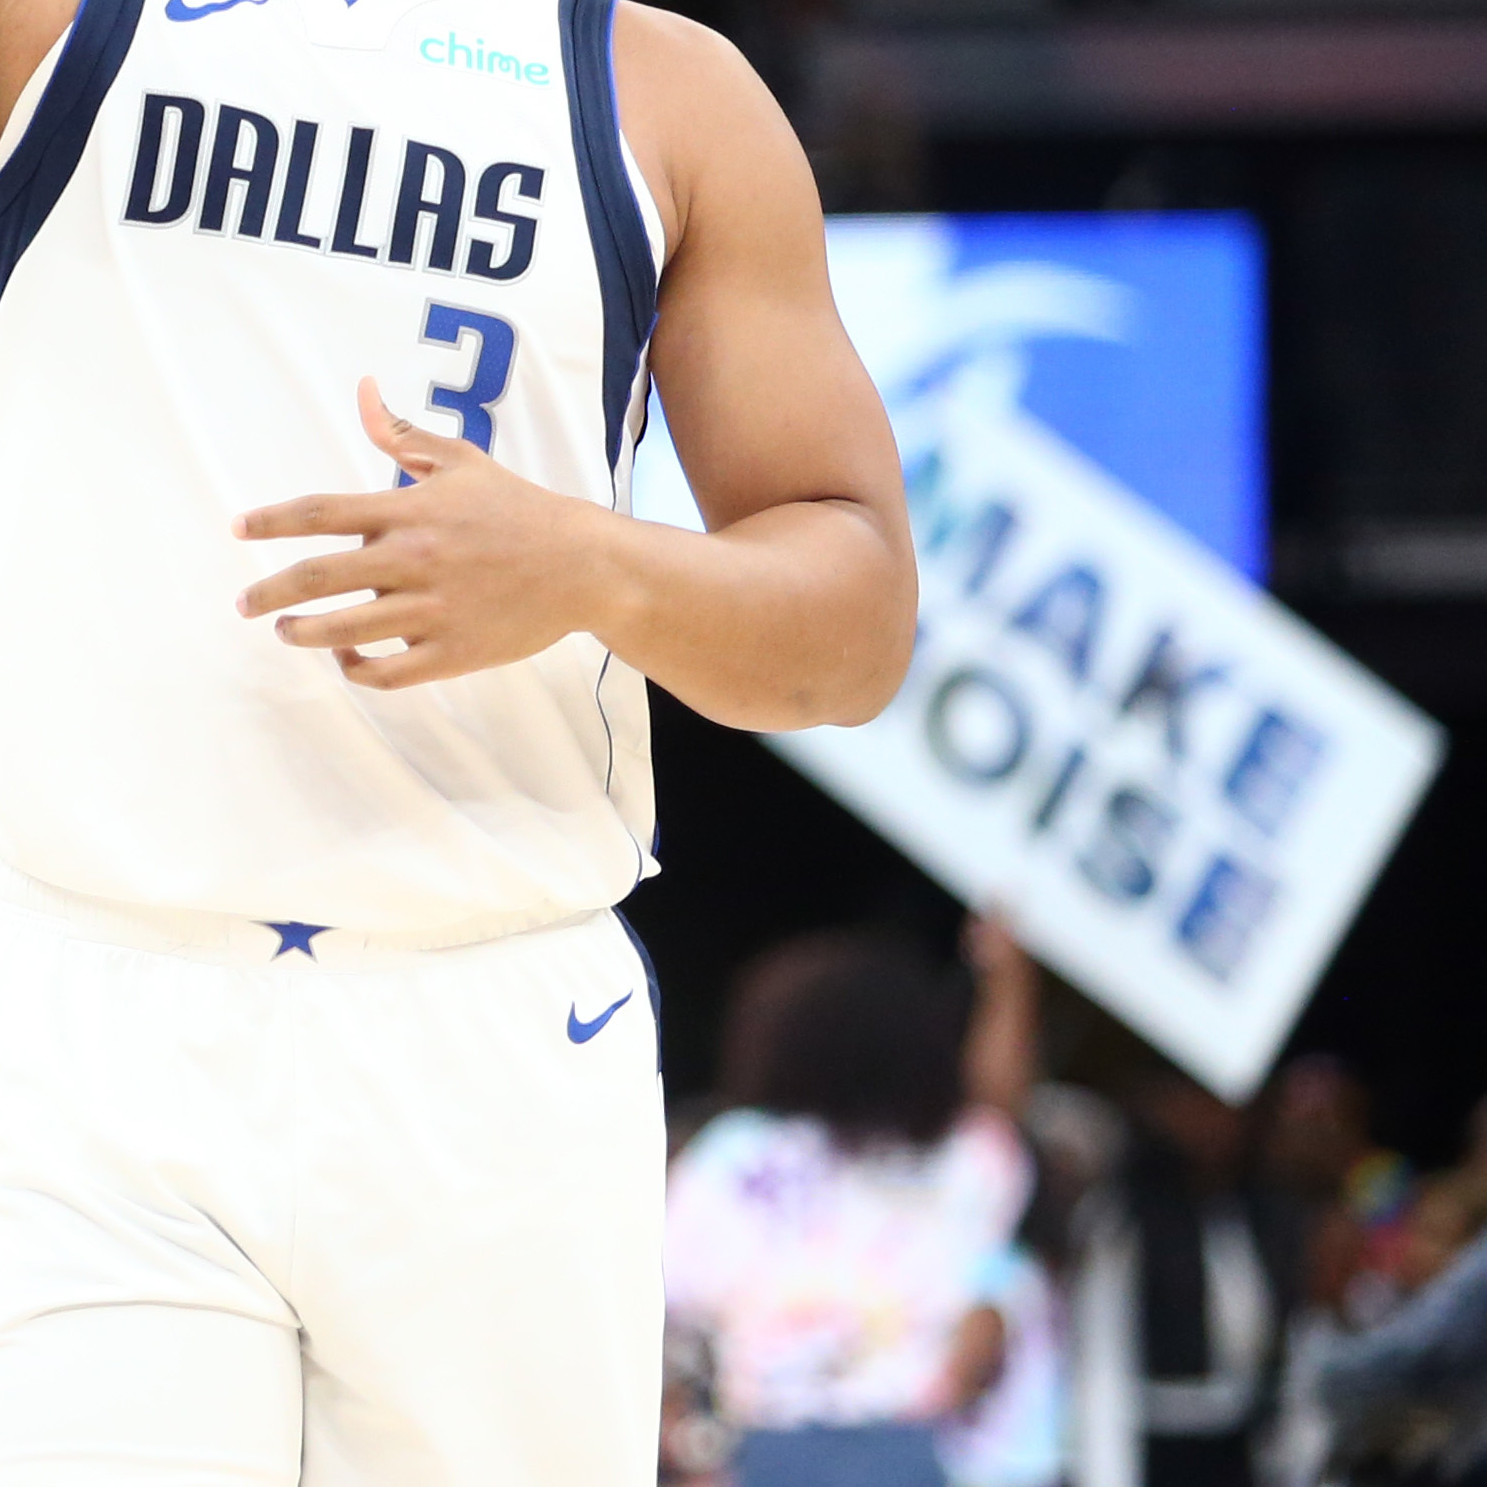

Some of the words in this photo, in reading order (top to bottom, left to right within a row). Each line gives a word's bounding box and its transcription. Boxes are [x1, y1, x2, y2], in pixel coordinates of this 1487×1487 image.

[419, 31, 550, 85] chime
[119, 89, 548, 286] DALLAS
[392, 297, 521, 491] 3
[915, 613, 1282, 981] OISE
